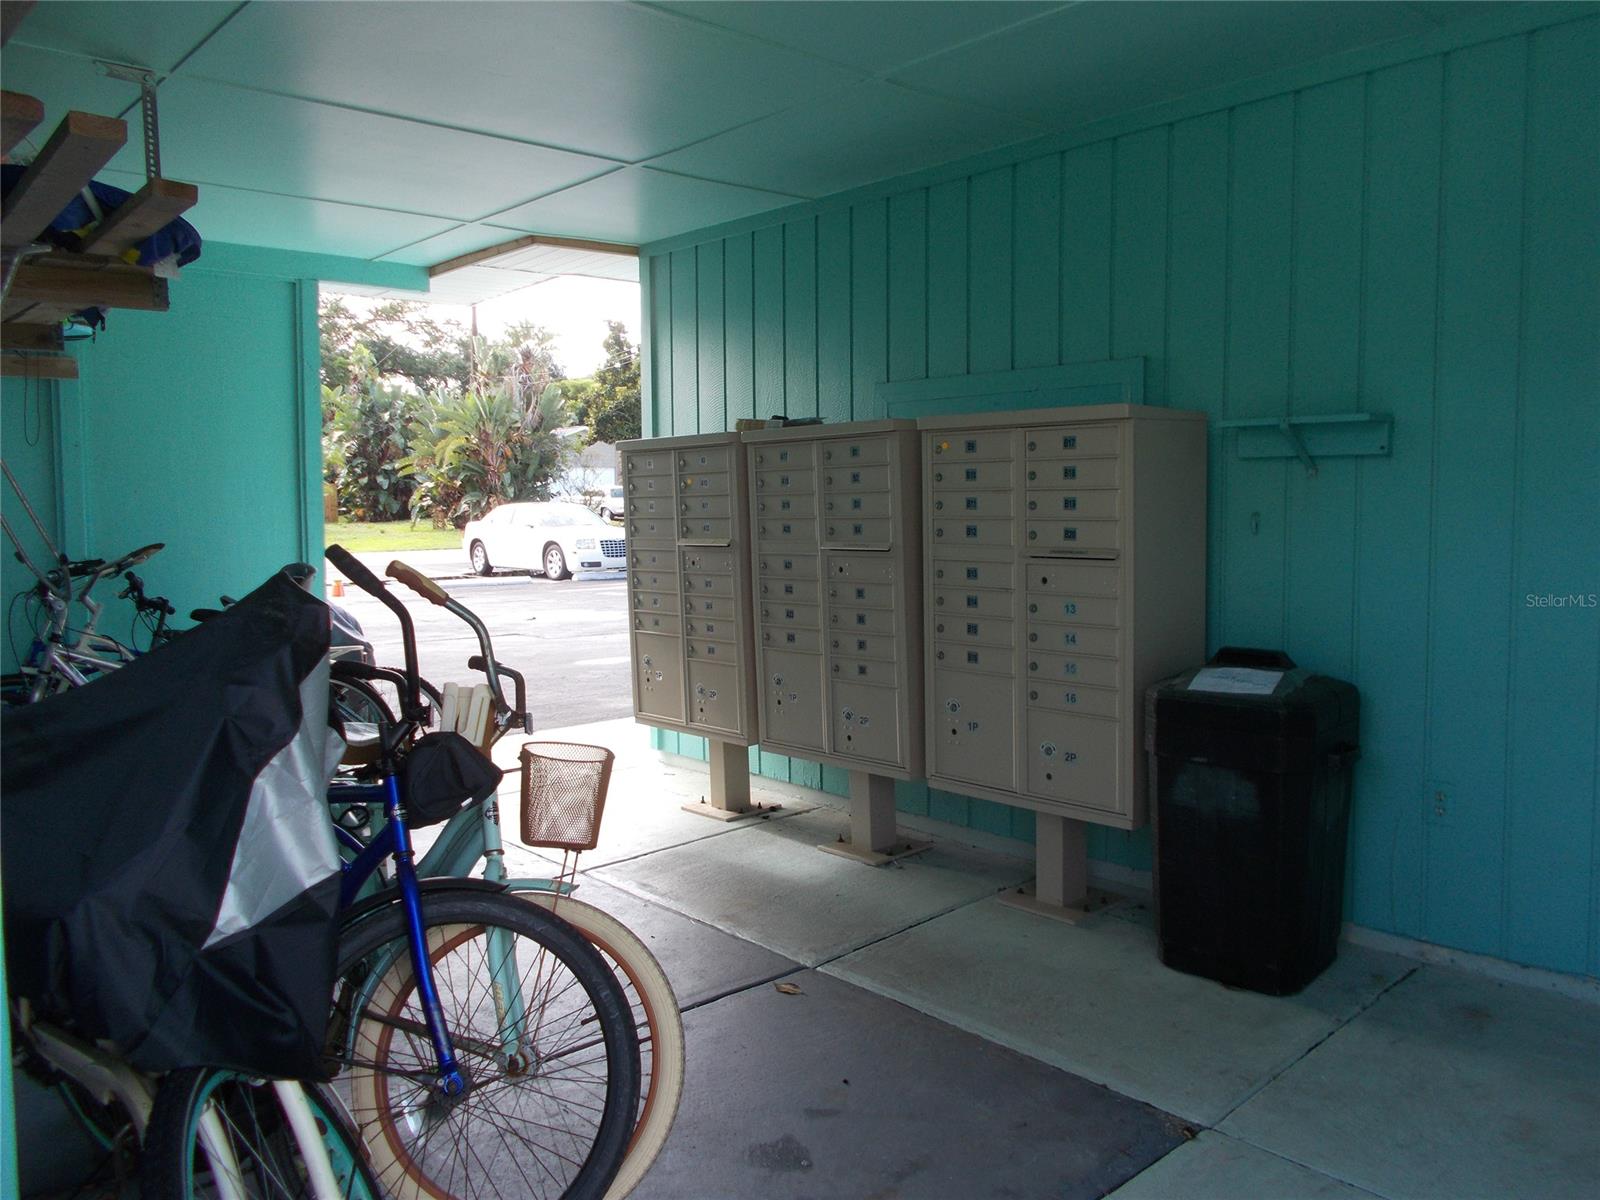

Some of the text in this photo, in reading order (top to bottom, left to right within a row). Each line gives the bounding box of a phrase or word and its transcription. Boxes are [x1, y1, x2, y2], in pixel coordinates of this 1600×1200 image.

[1065, 603, 1076, 614] 13
[1065, 634, 1076, 644] 14
[1065, 693, 1076, 703] 16
[968, 721, 978, 732] 1P
[1065, 752, 1076, 762] 2P
